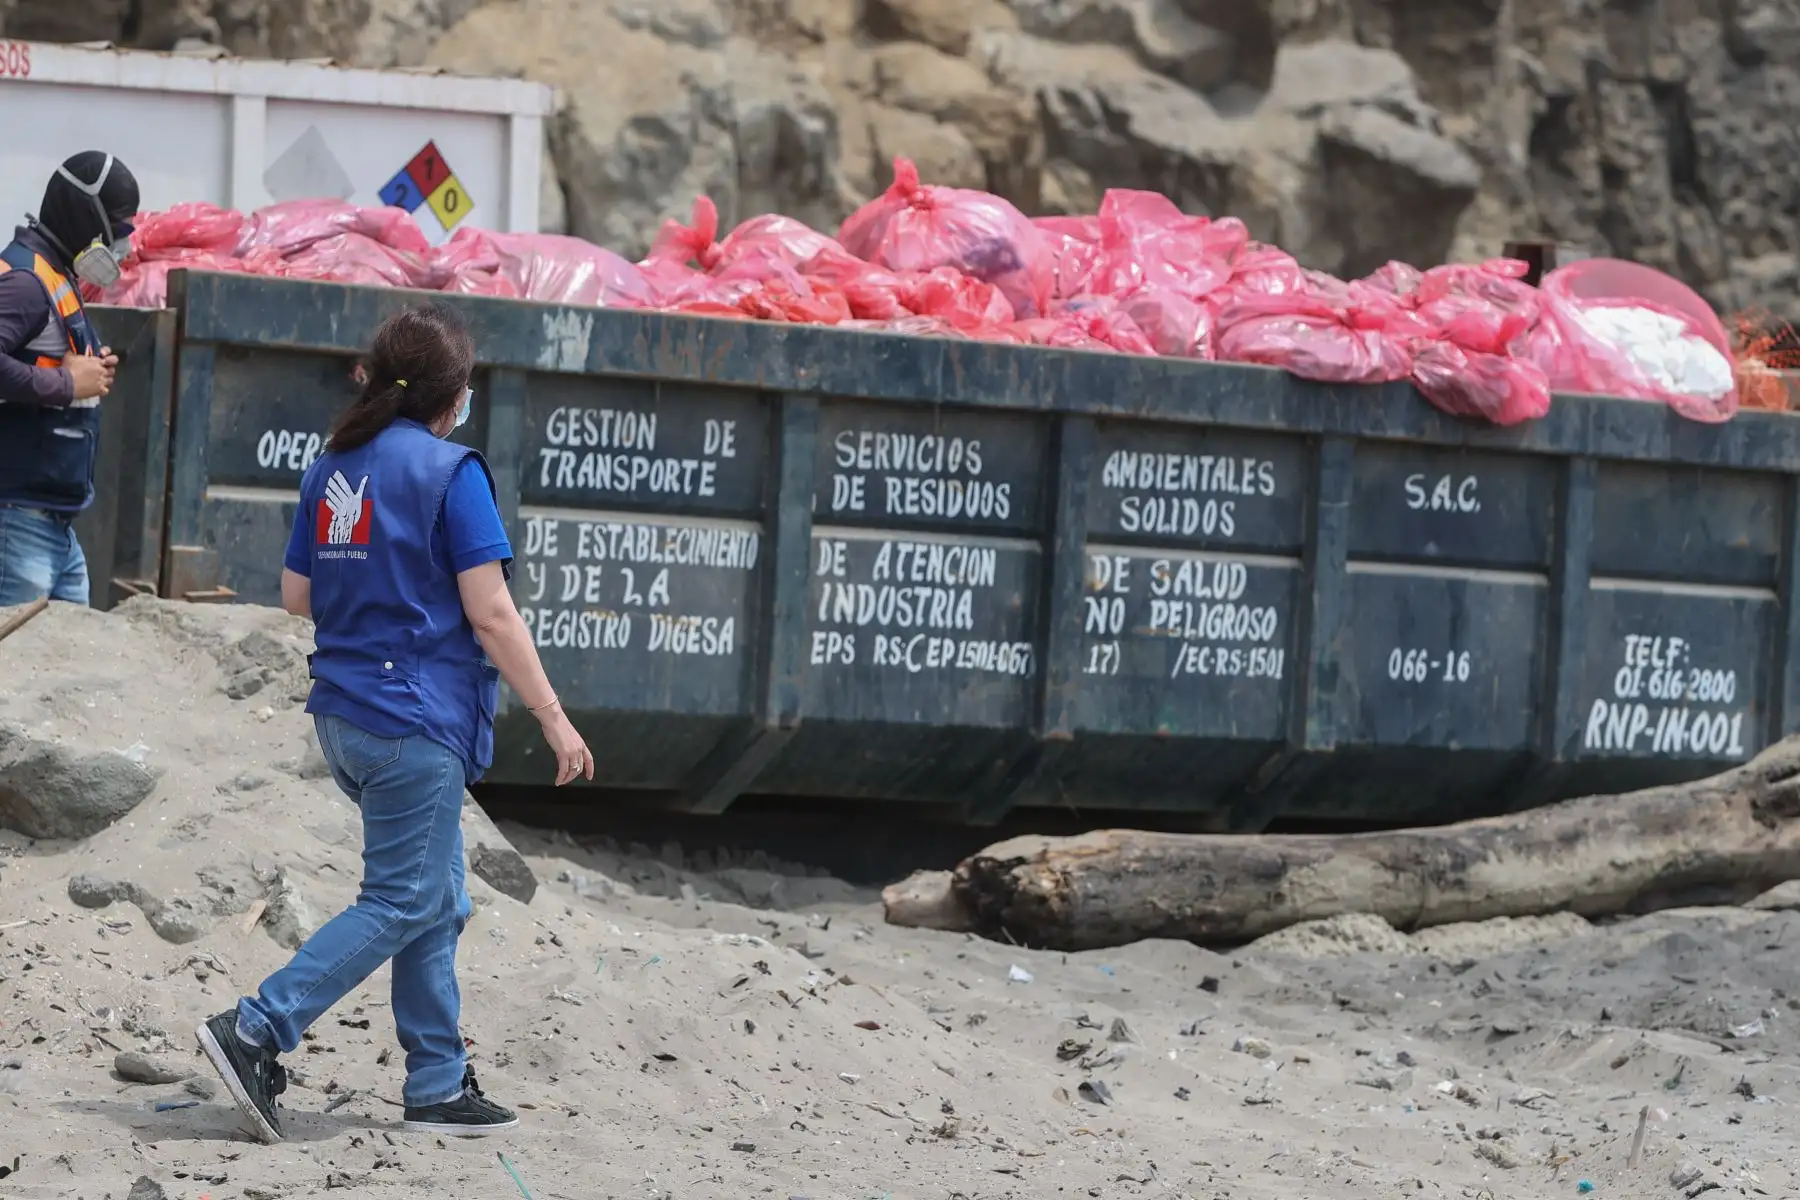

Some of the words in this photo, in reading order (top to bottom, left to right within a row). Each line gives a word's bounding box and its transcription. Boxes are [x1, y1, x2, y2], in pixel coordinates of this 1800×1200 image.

[424, 156, 434, 181] 1
[444, 188, 458, 214] 0
[257, 429, 328, 471] OPER
[546, 406, 657, 451] GESTION
[703, 419, 736, 458] DE
[834, 430, 983, 476] SERVICIOS
[1102, 450, 1276, 496] AMBIENTALES
[539, 447, 717, 497] TRANSPORTE
[831, 474, 866, 512] DE
[885, 476, 1010, 520] RESIDUOS
[1119, 496, 1236, 537] SOLIDOS
[524, 515, 559, 558] DE
[577, 522, 761, 571] ESTABLECIMIENTO
[816, 540, 847, 577] DE
[872, 541, 997, 587] ATENCION
[1091, 555, 1131, 593] DE
[1150, 559, 1248, 600] SALUD
[526, 562, 546, 602] Y
[559, 564, 602, 604] DE
[818, 581, 974, 631] INDUSTRIA
[1084, 596, 1126, 635] NO
[1150, 600, 1278, 642] PELIGROSO
[647, 613, 735, 656] DIGESA
[810, 631, 856, 666] EPS
[1388, 647, 1470, 683] 066-16
[1624, 633, 1690, 669] TELF:
[1584, 698, 1744, 756] RNP-IN-001
